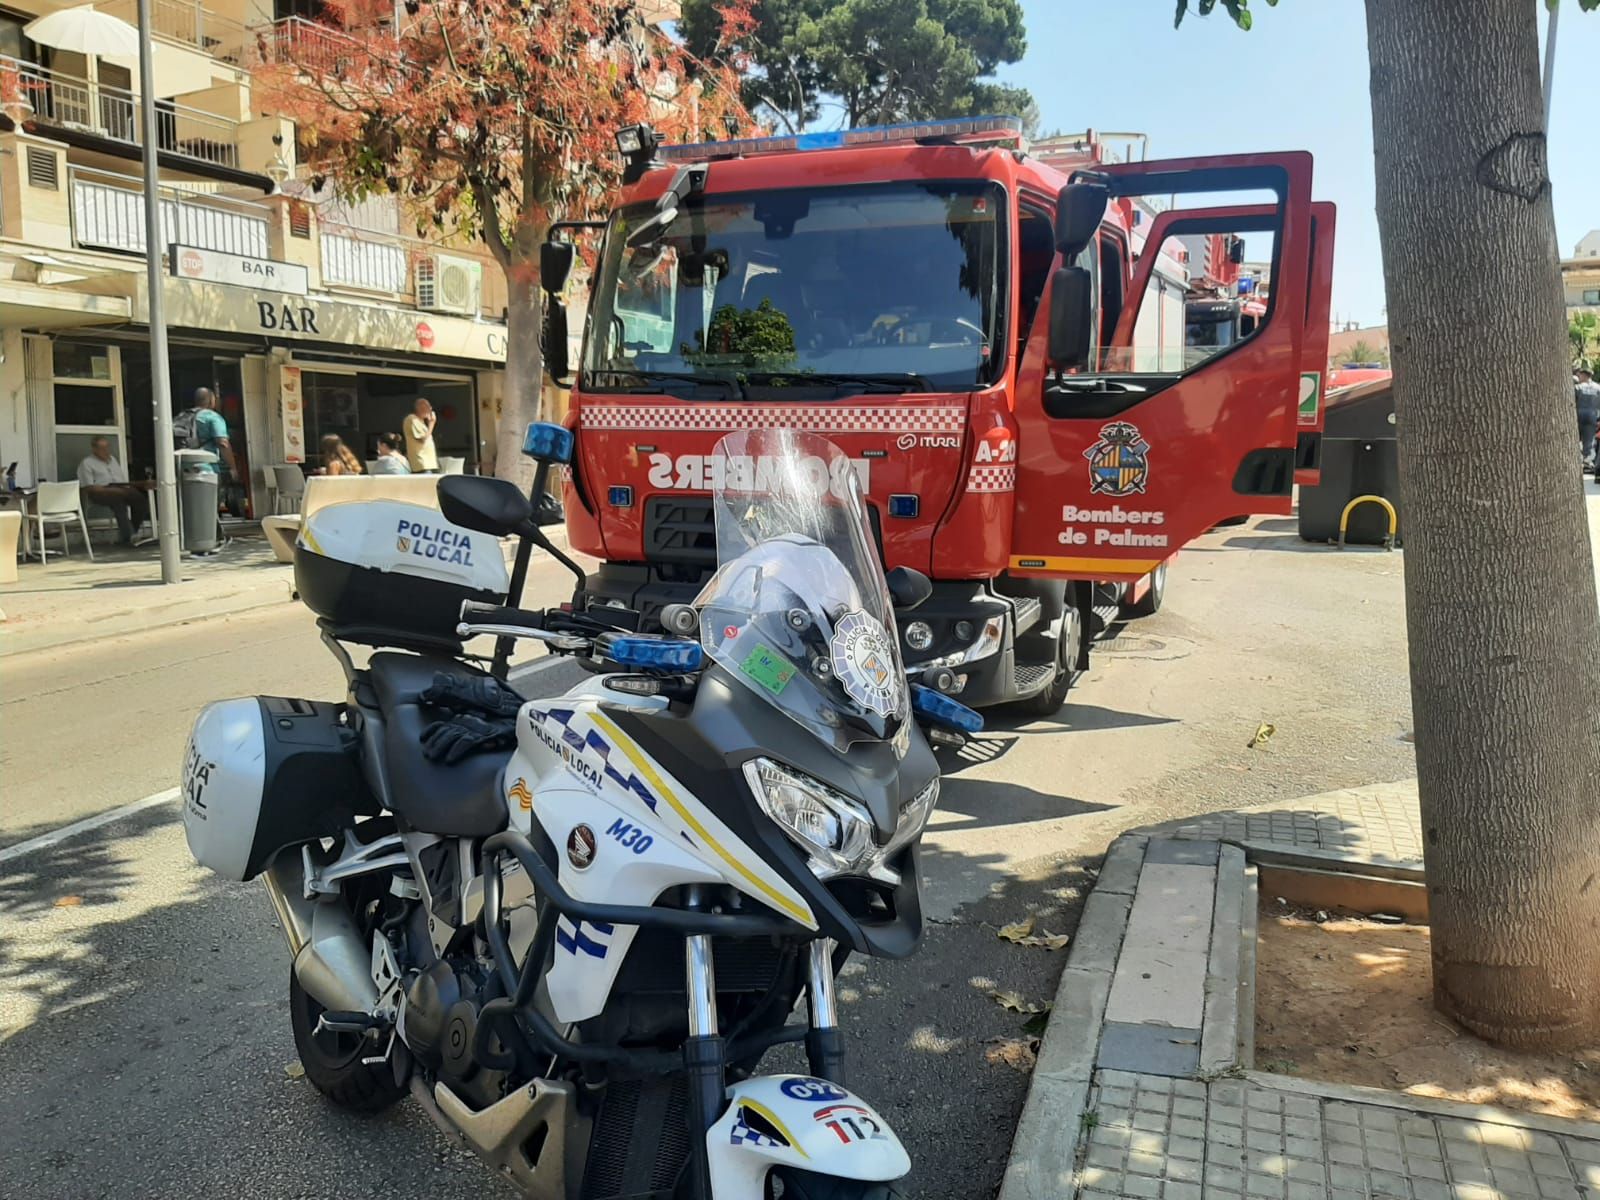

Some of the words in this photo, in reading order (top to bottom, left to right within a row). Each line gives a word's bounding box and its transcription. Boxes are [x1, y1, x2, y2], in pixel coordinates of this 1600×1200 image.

[242, 261, 275, 278] BAR
[257, 301, 320, 334] BAR
[920, 437, 960, 448] ITURRI
[975, 440, 1016, 462] A-20
[1062, 505, 1164, 524] Bombers
[397, 520, 472, 549] POLICIA
[1058, 527, 1088, 544] de
[1094, 528, 1168, 546] Palma
[413, 540, 474, 567] LOCAL
[846, 626, 868, 651] POLICIA
[530, 721, 562, 758] POLICIA
[570, 754, 603, 790] LOCAL
[606, 817, 654, 855] M30
[825, 1116, 889, 1144] 112
